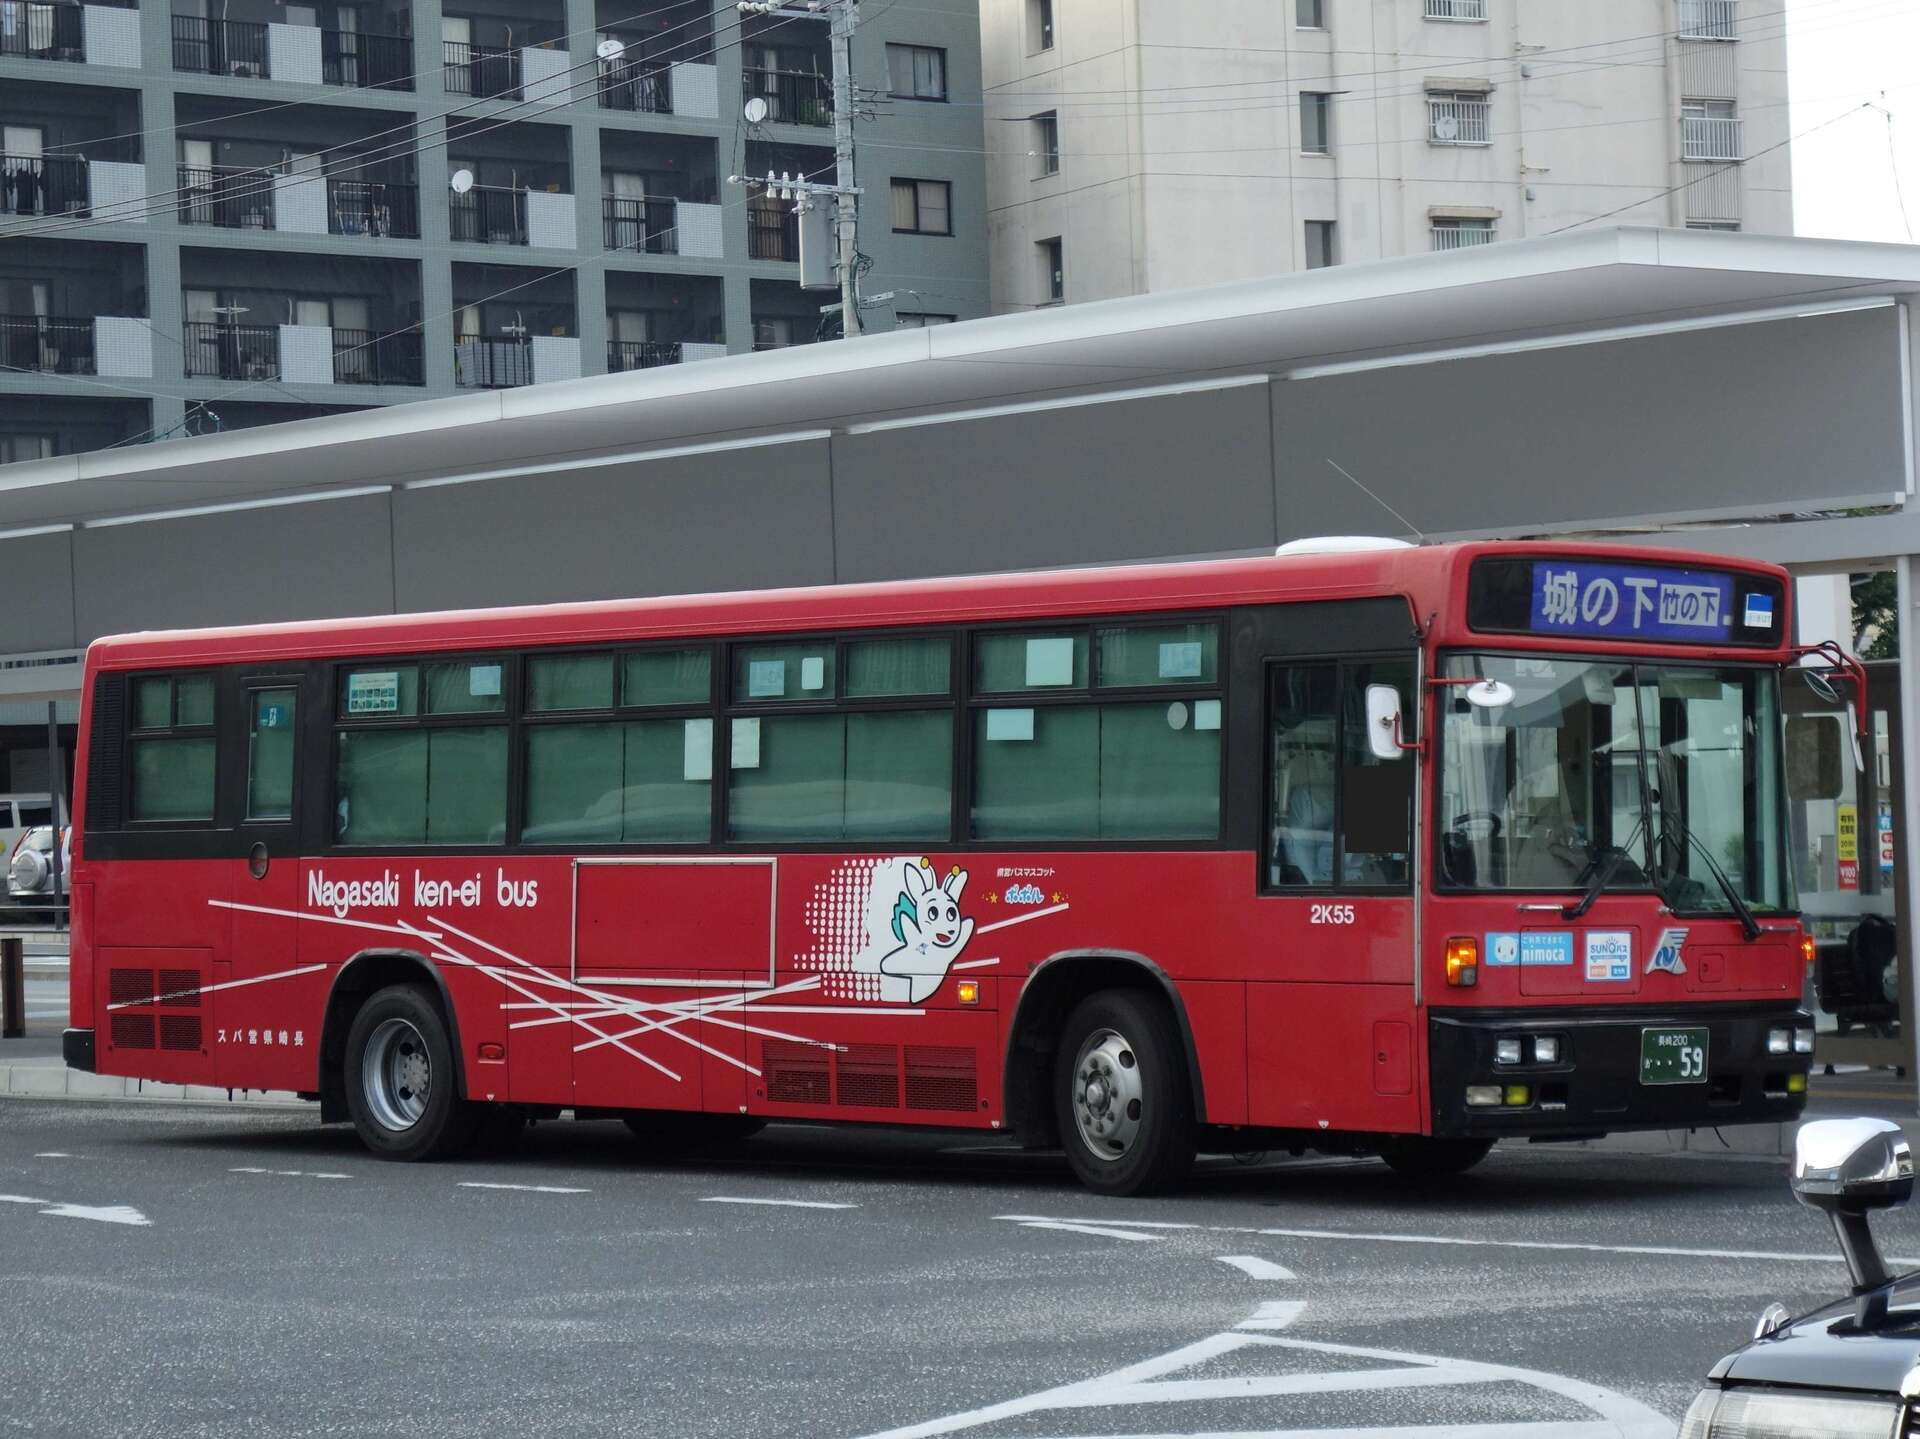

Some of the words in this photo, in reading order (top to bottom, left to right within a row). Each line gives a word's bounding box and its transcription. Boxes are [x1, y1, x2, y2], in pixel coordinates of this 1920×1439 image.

[1543, 570, 1657, 629] 城の下
[1662, 587, 1719, 624] 竹の下
[308, 869, 400, 918] Nagasaki
[414, 868, 481, 907] ken-ei
[497, 867, 538, 907] bus
[1310, 904, 1355, 924] 2K55
[1522, 944, 1565, 962] nimoca
[1680, 1047, 1704, 1077] 59
